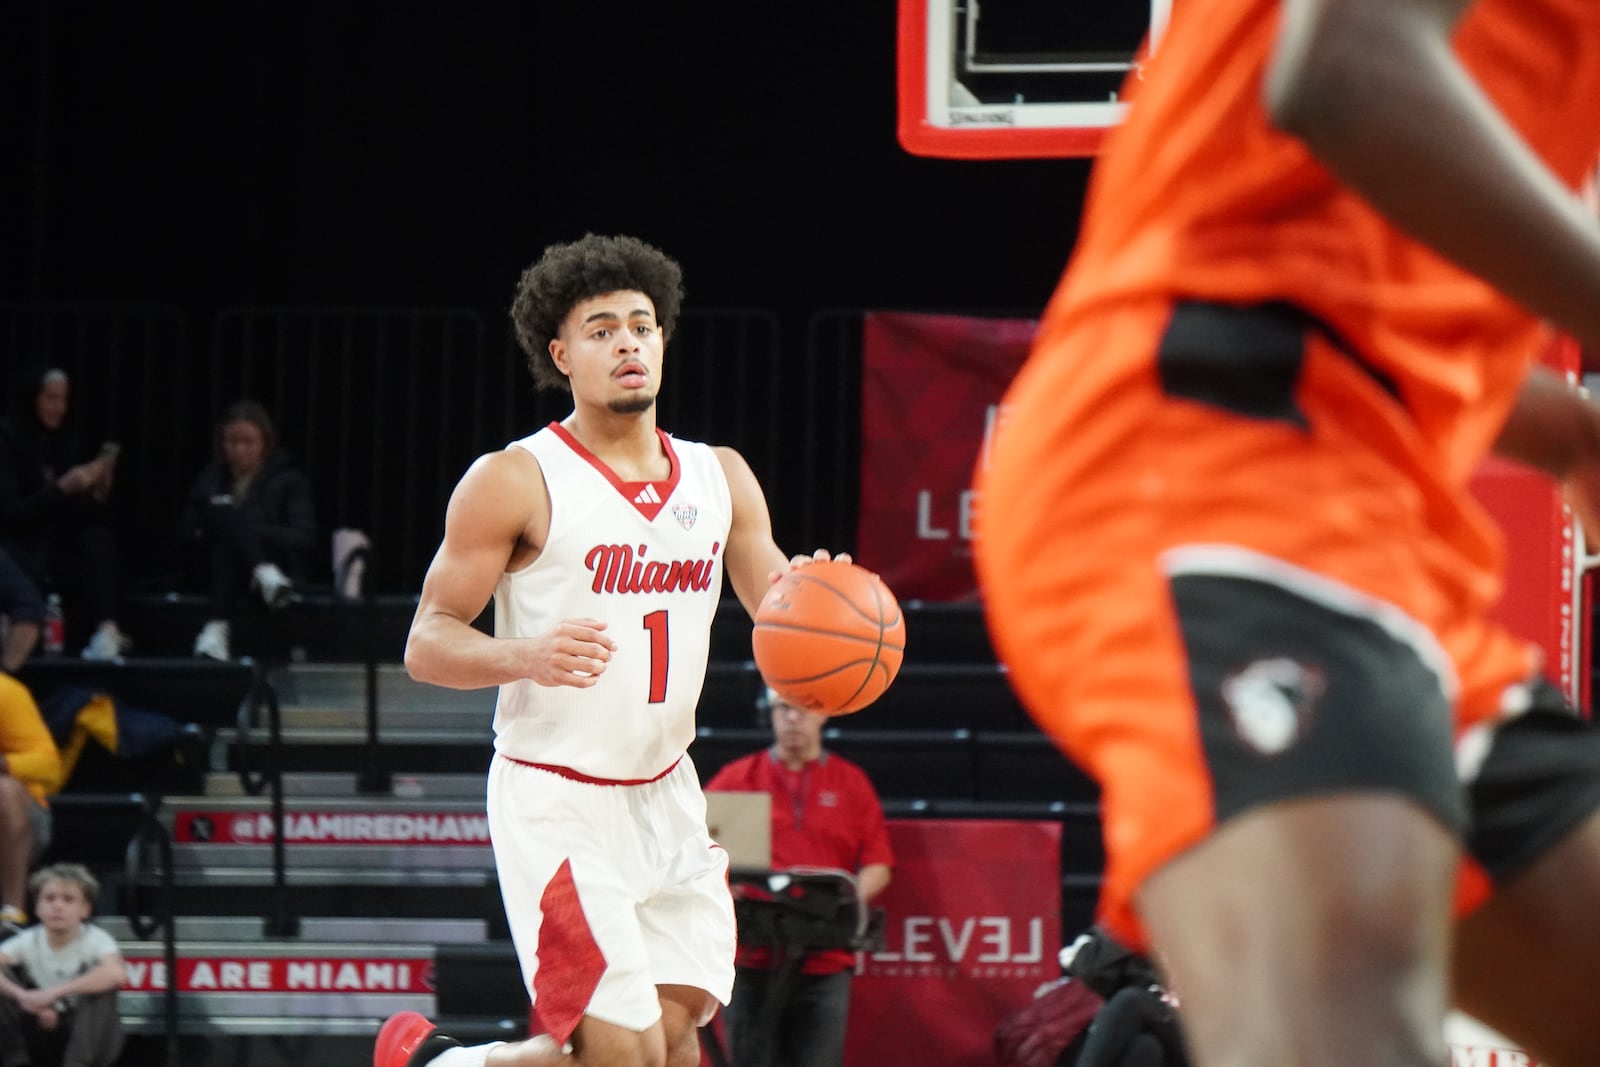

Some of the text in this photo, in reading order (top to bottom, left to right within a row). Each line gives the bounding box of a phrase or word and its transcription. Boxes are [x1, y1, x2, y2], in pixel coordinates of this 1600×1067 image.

[584, 541, 720, 594] Miami
[643, 609, 670, 704] 1
[189, 960, 272, 989] ARE
[286, 961, 411, 990] MIAMI
